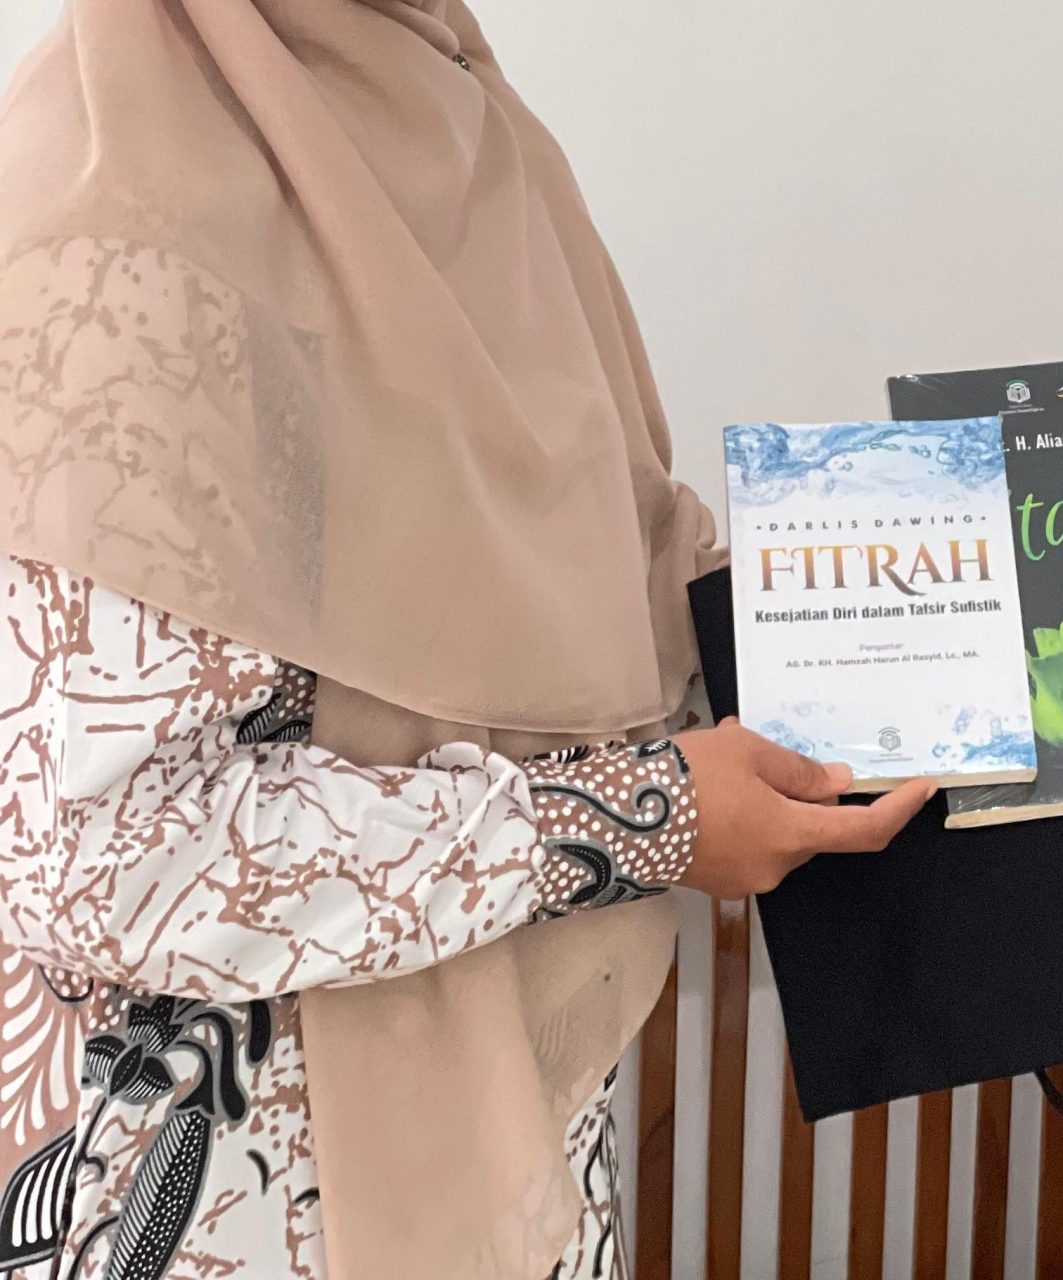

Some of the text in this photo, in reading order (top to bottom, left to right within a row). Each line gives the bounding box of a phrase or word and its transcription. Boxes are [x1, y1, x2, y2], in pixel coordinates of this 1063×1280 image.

[1016, 435, 1031, 451] H.
[769, 514, 973, 532] DARLIS DAWING
[758, 538, 994, 596] FITRAH
[755, 599, 1002, 623] Kesejatian Diri dalam Tafsir Sufistik
[836, 657, 872, 666] Hamzah
